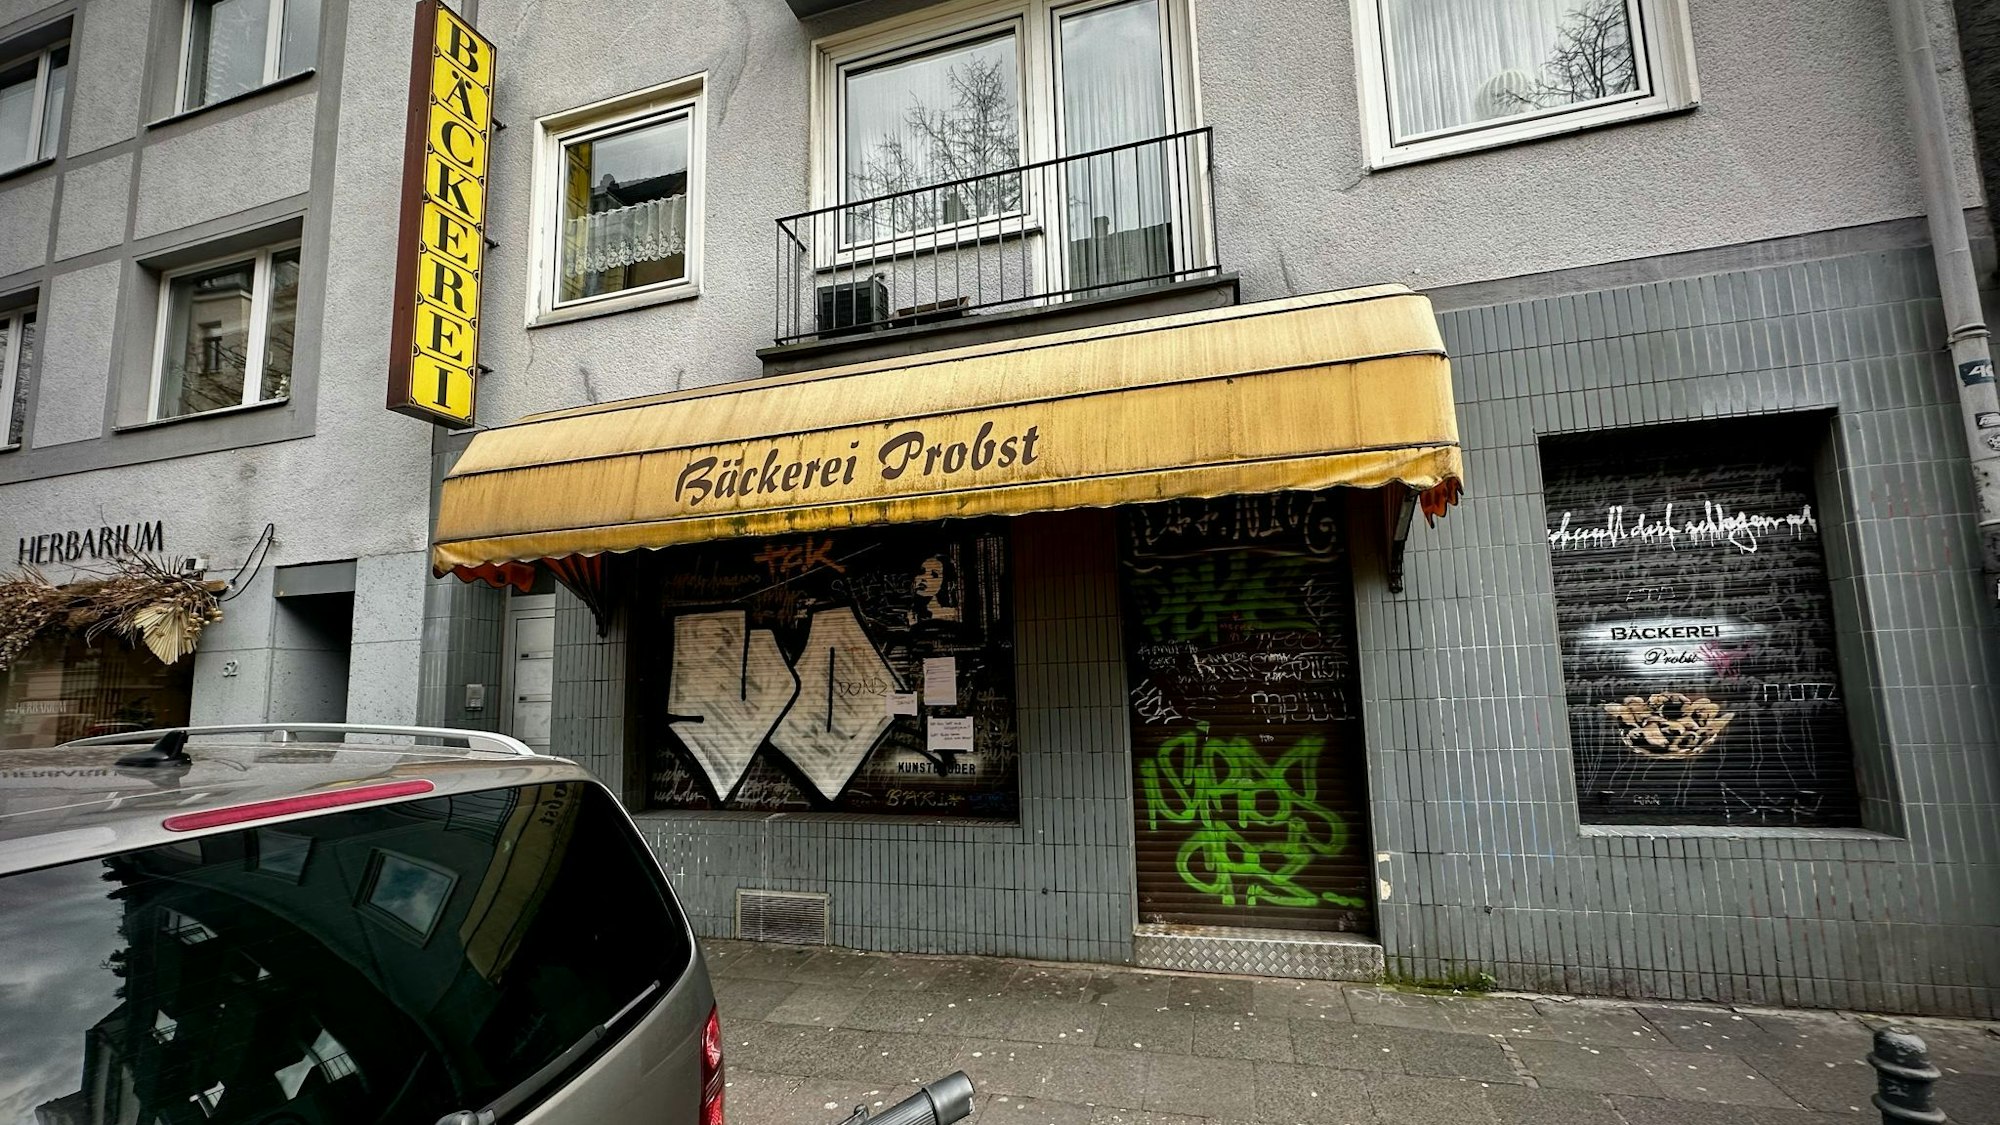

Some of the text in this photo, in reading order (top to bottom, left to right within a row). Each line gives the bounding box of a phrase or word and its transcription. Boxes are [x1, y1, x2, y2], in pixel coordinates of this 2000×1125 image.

[427, 17, 478, 410] BÄCKEREI
[675, 421, 1040, 506] Bäckerei Probst
[18, 520, 163, 565] HERBARIUM
[1611, 625, 1720, 640] BÄCKEREI
[223, 660, 238, 678] 52
[1644, 648, 1700, 665] Probst
